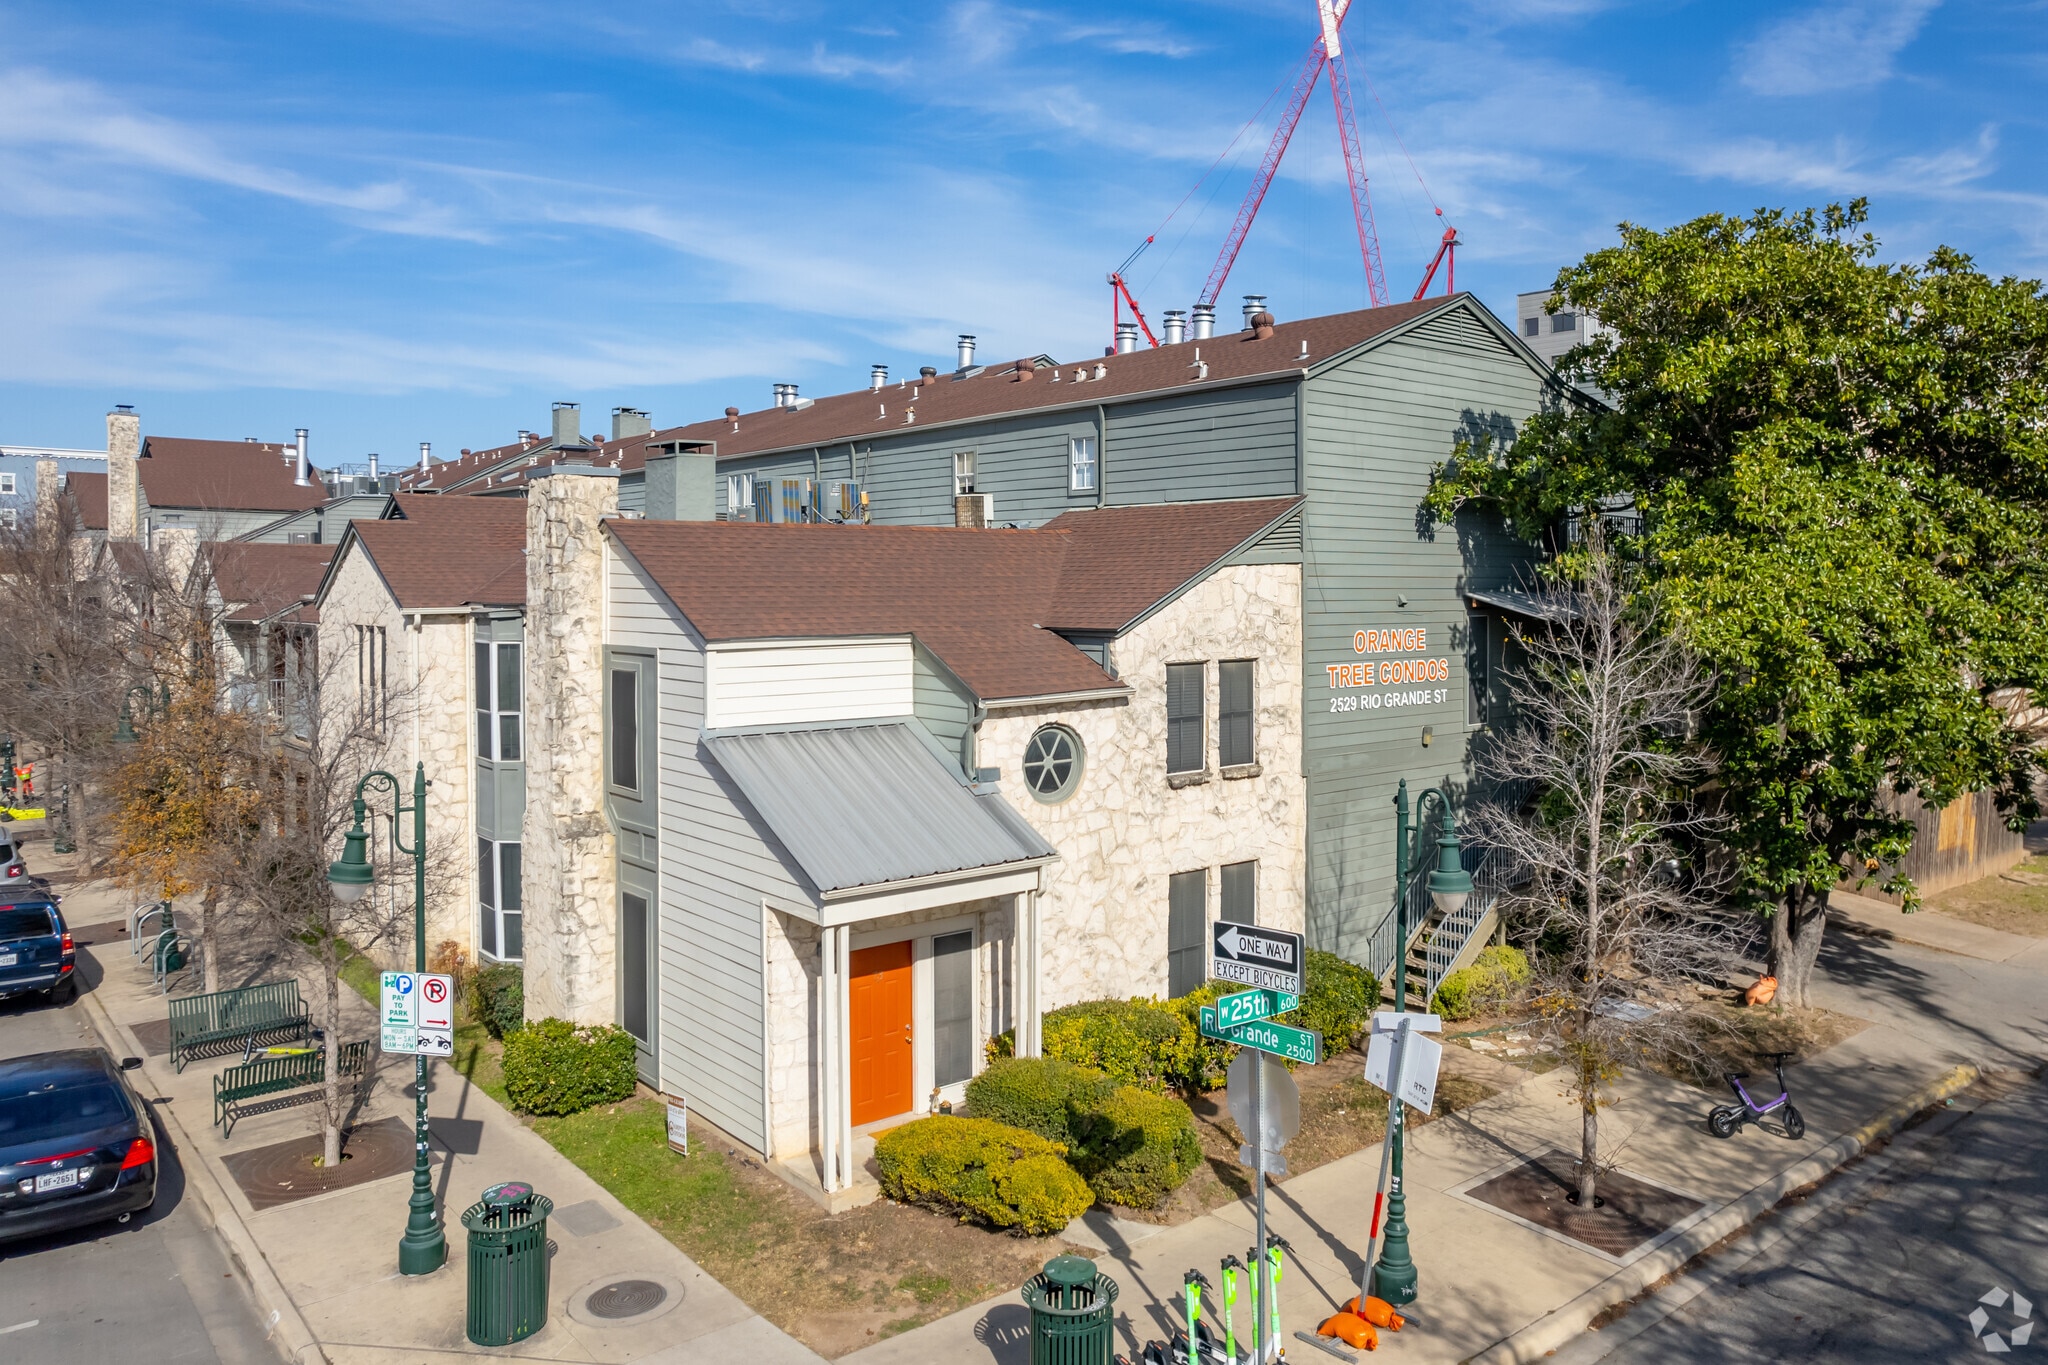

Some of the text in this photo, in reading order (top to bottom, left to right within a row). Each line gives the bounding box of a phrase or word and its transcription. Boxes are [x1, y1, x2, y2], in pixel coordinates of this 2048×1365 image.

[1354, 628, 1426, 654] ORANGE
[1326, 658, 1449, 688] TREE CONDOS
[1330, 688, 1448, 713] 2529 RIO GRANDE ST
[1239, 937, 1289, 959] ONE WAY
[1216, 962, 1296, 992] EXCEPT BICYCLES
[1221, 994, 1297, 1022] W 25th 600
[1286, 1044, 1313, 1061] 2500
[1300, 1034, 1312, 1047] ST
[1413, 1081, 1427, 1095] RTC
